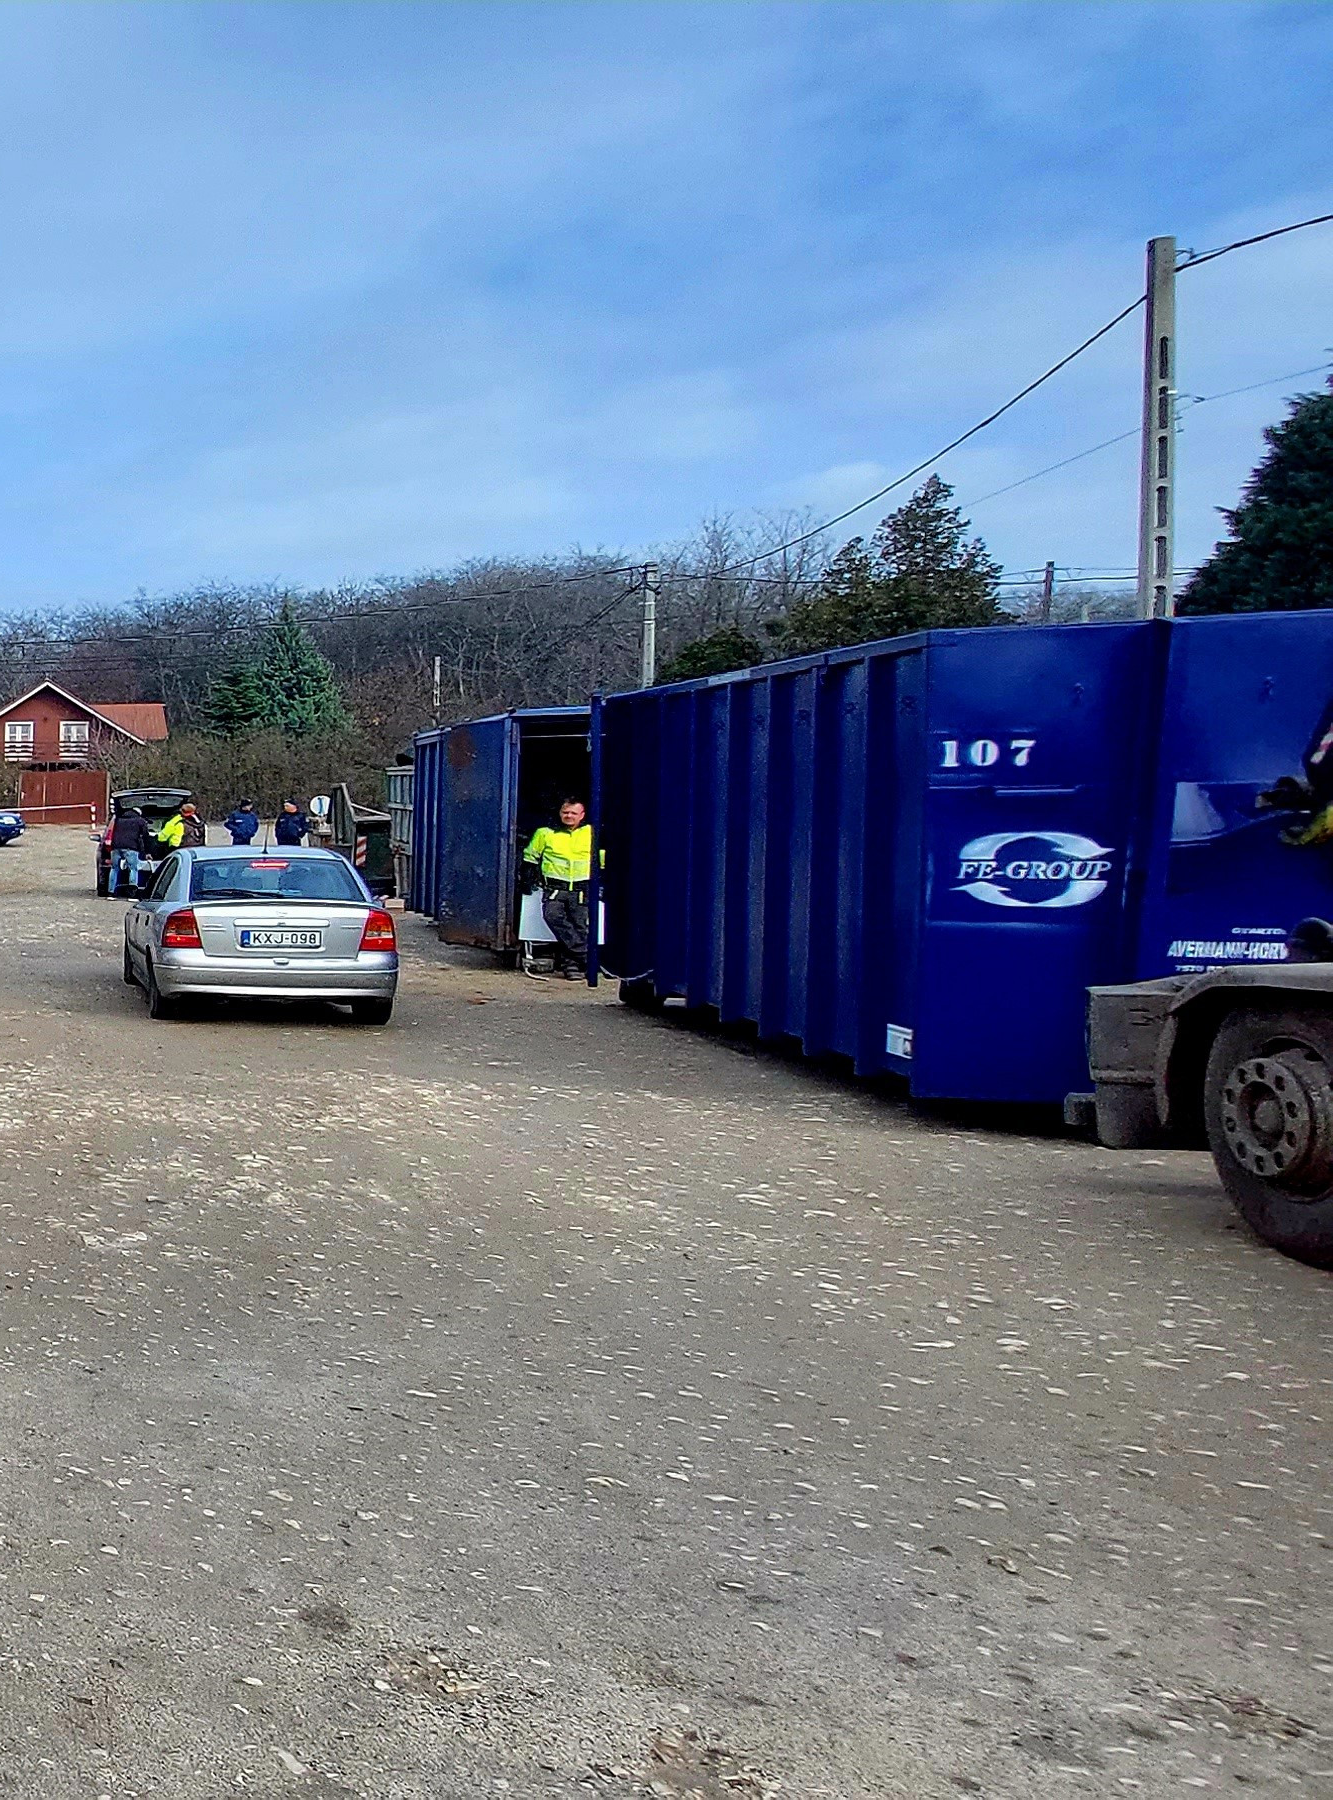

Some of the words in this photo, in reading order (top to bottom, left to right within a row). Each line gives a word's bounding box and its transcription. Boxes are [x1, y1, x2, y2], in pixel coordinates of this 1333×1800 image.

[940, 739, 1037, 768] 107
[956, 861, 1113, 880] FE-GROUP
[252, 933, 317, 945] KXJ-098
